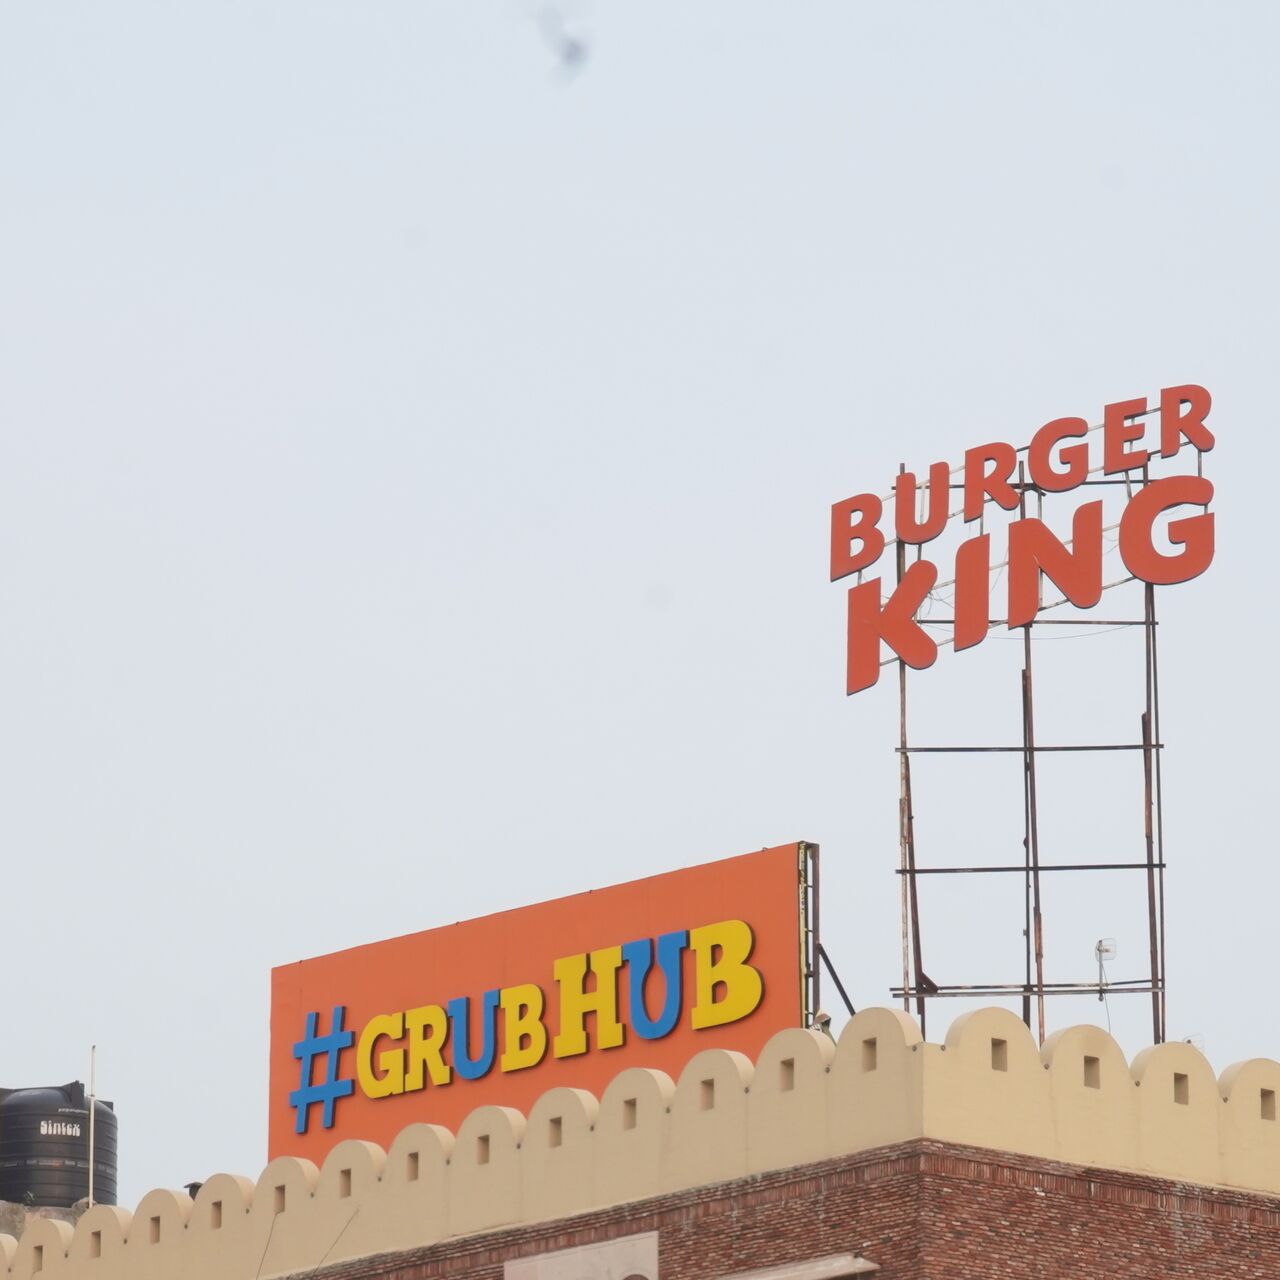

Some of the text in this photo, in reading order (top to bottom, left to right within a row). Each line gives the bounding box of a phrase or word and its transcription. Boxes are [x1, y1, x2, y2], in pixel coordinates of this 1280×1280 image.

[830, 384, 1215, 582] BURGER
[847, 475, 1215, 696] KING
[40, 1120, 80, 1137] Sintex
[289, 920, 763, 1134] #GRUBHUB
